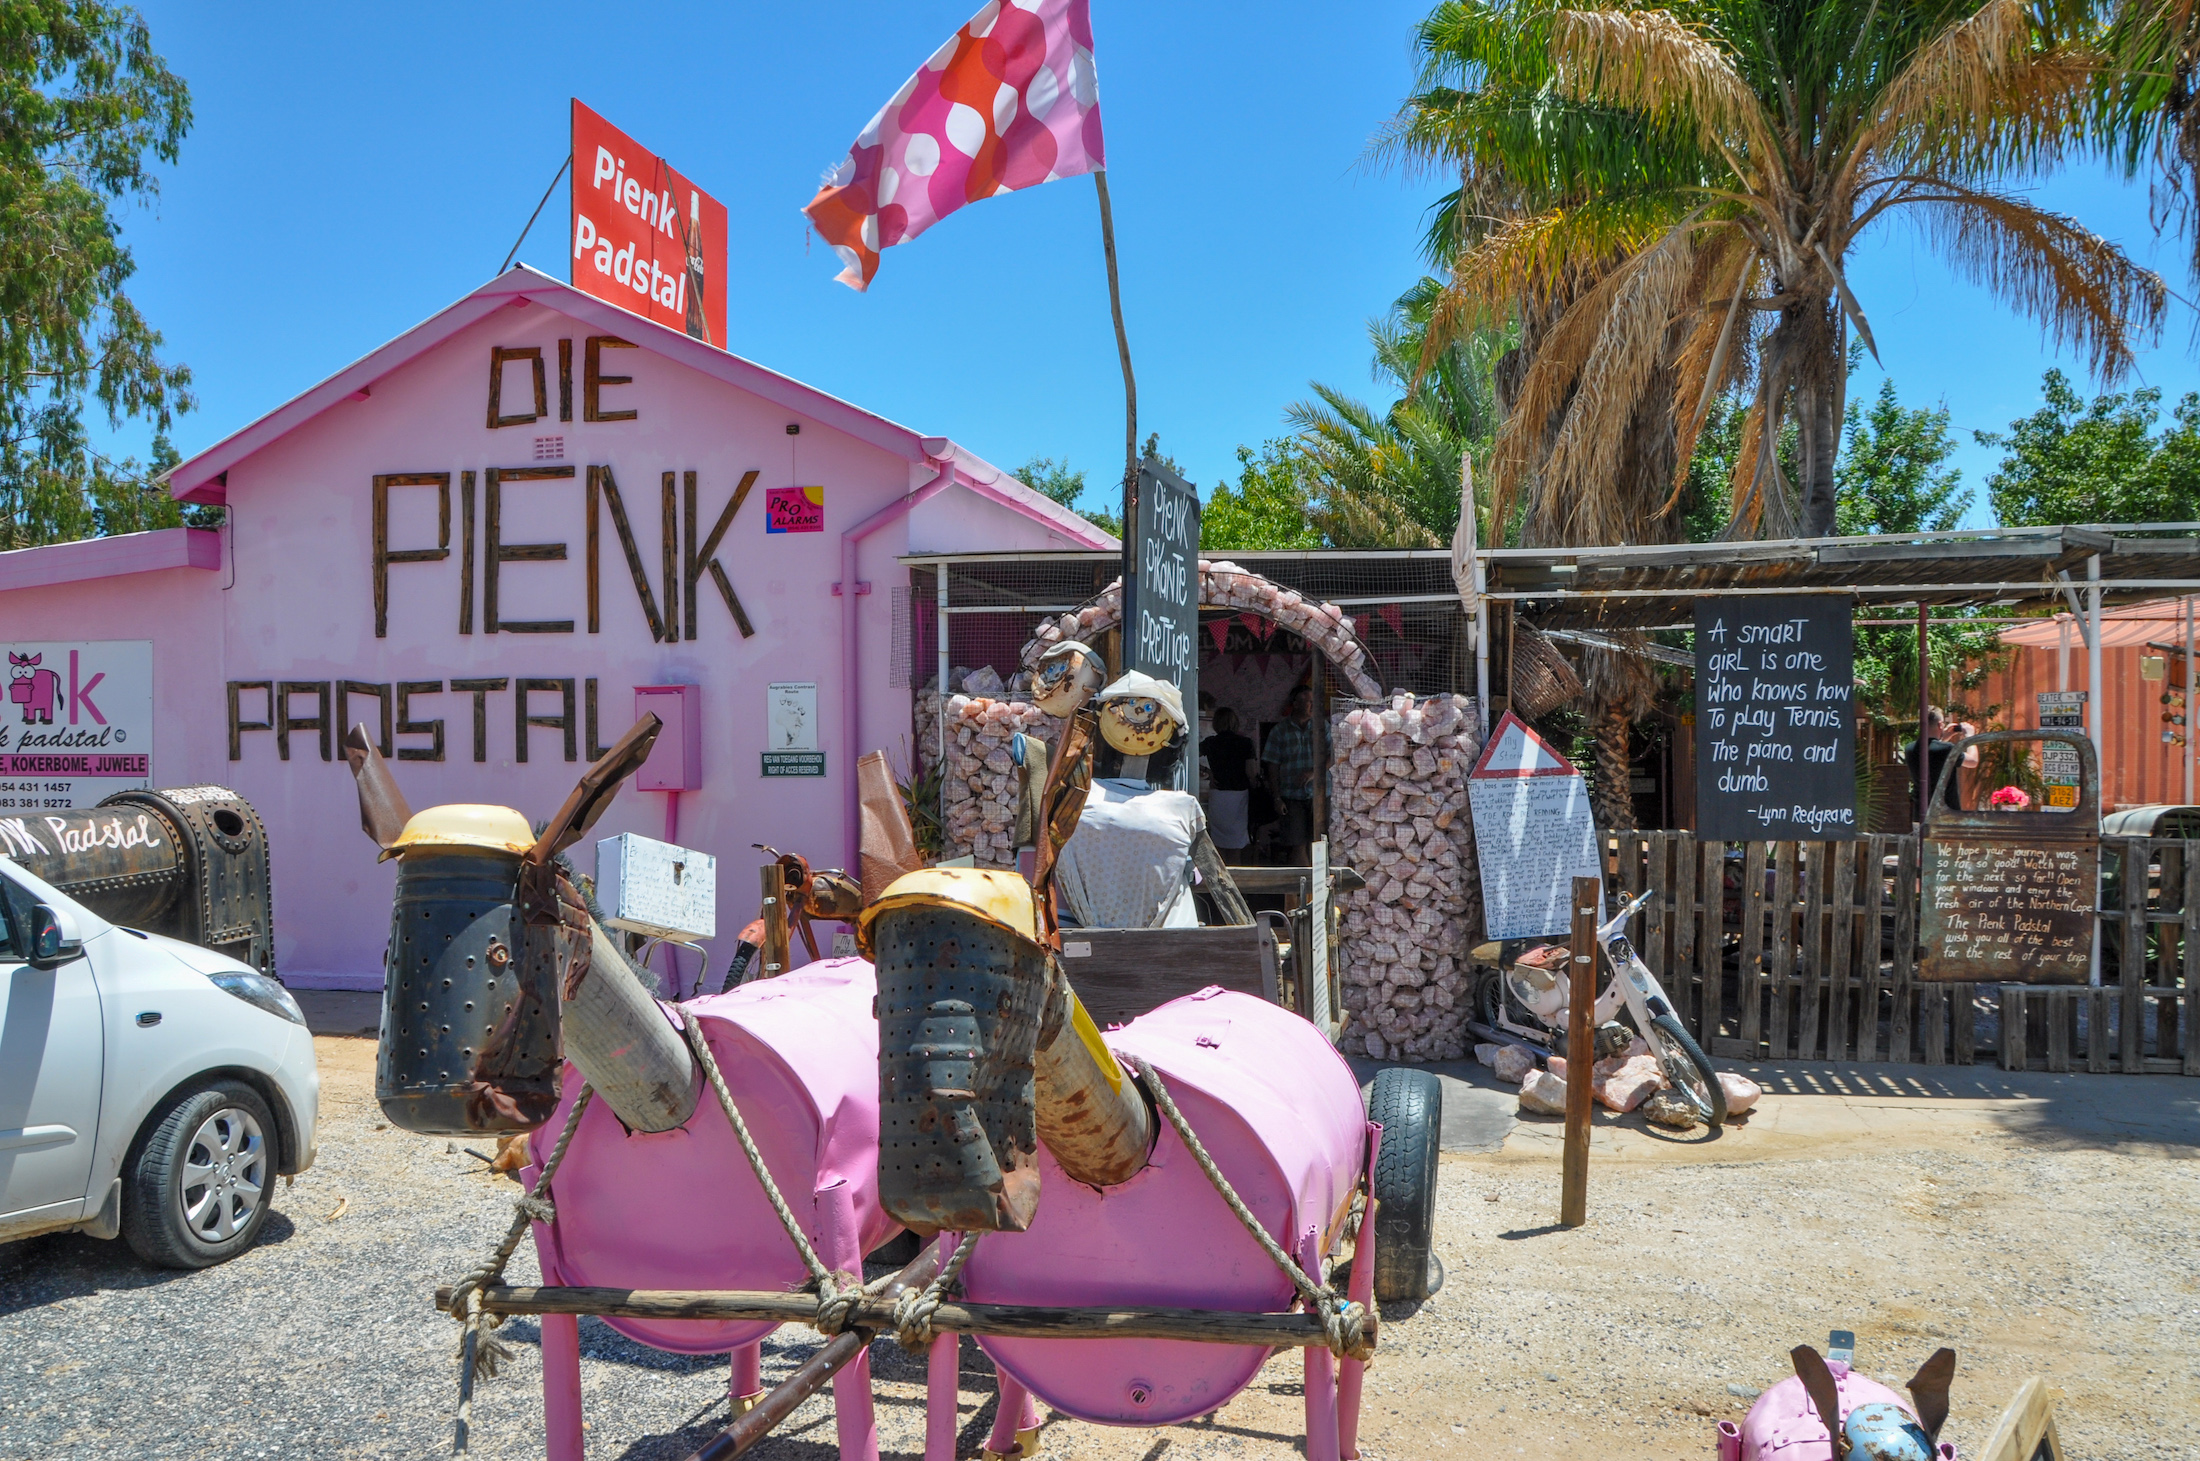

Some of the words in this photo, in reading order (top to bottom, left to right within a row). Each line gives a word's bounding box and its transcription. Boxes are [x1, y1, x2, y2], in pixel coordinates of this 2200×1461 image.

[593, 145, 676, 240] Pienk
[574, 214, 686, 315] Padstal
[486, 335, 639, 429] DIE
[770, 497, 801, 516] PRO
[773, 515, 819, 525] ALARMS
[372, 465, 760, 644] PIENK
[1707, 617, 1728, 644] A
[1761, 649, 1777, 670] is
[1785, 651, 1827, 671] one
[1707, 676, 1742, 703] who
[1751, 677, 1807, 701] knows
[1815, 678, 1850, 701] how
[2037, 693, 2061, 702] DEXTER
[226, 677, 610, 764] PADSTAL
[1707, 708, 1725, 729] To
[1504, 736, 1517, 750] My
[1711, 738, 1739, 762] The
[1803, 738, 1838, 763] and
[11, 757, 92, 775] KOKERBOME,
[96, 757, 145, 772] JUWELE
[772, 755, 780, 763] VAN
[780, 755, 798, 763] TOEGANG
[2059, 752, 2073, 761] 332
[768, 766, 779, 774] RIGHT
[780, 766, 785, 774] OF
[1718, 765, 1769, 792] dumb.
[0, 783, 15, 792] 54
[19, 783, 39, 792] 431
[44, 783, 71, 792] 1457
[0, 799, 16, 808] 83
[20, 799, 38, 808] 381
[44, 799, 71, 808] 9272
[2054, 796, 2070, 805] AEZ
[45, 815, 159, 854] Padstal
[1937, 842, 1952, 857] We
[1957, 843, 1980, 861] hope
[1986, 848, 2006, 859] your
[2013, 846, 2048, 860] journey
[2056, 850, 2078, 860] was,
[1937, 860, 1948, 868] so
[1976, 860, 1988, 868] so
[1994, 857, 2020, 872] good!
[2024, 859, 2054, 870] Watch
[2060, 860, 2077, 870] out
[1936, 871, 1951, 882] for
[1956, 871, 1974, 882] the
[1983, 871, 2006, 882] next
[2057, 873, 2081, 886] Open
[1936, 885, 1956, 897] your
[1962, 884, 1999, 893] windows
[2005, 884, 2022, 894] and
[2027, 887, 2050, 898] enjoy
[2056, 887, 2073, 898] the
[1935, 898, 1959, 909] fresh
[1968, 900, 1983, 909] air
[1989, 896, 1999, 908] of
[2007, 897, 2024, 909] the
[2029, 898, 2069, 911] Northern
[2070, 899, 2093, 916] Cape
[1947, 913, 1969, 929] The
[1978, 913, 2005, 930] Pienk
[2014, 914, 2052, 933] Padstal
[1945, 932, 1968, 942] wish
[1975, 934, 1991, 947] you
[1997, 933, 2010, 943] all
[2014, 933, 2027, 944] of
[2028, 935, 2043, 945] the
[2052, 936, 2074, 947] best
[1944, 945, 1959, 958] for
[1966, 946, 1983, 958] the
[1994, 949, 2012, 960] rest
[2022, 948, 2036, 961] of
[2037, 953, 2061, 967] your
[2067, 951, 2087, 968] trip.
